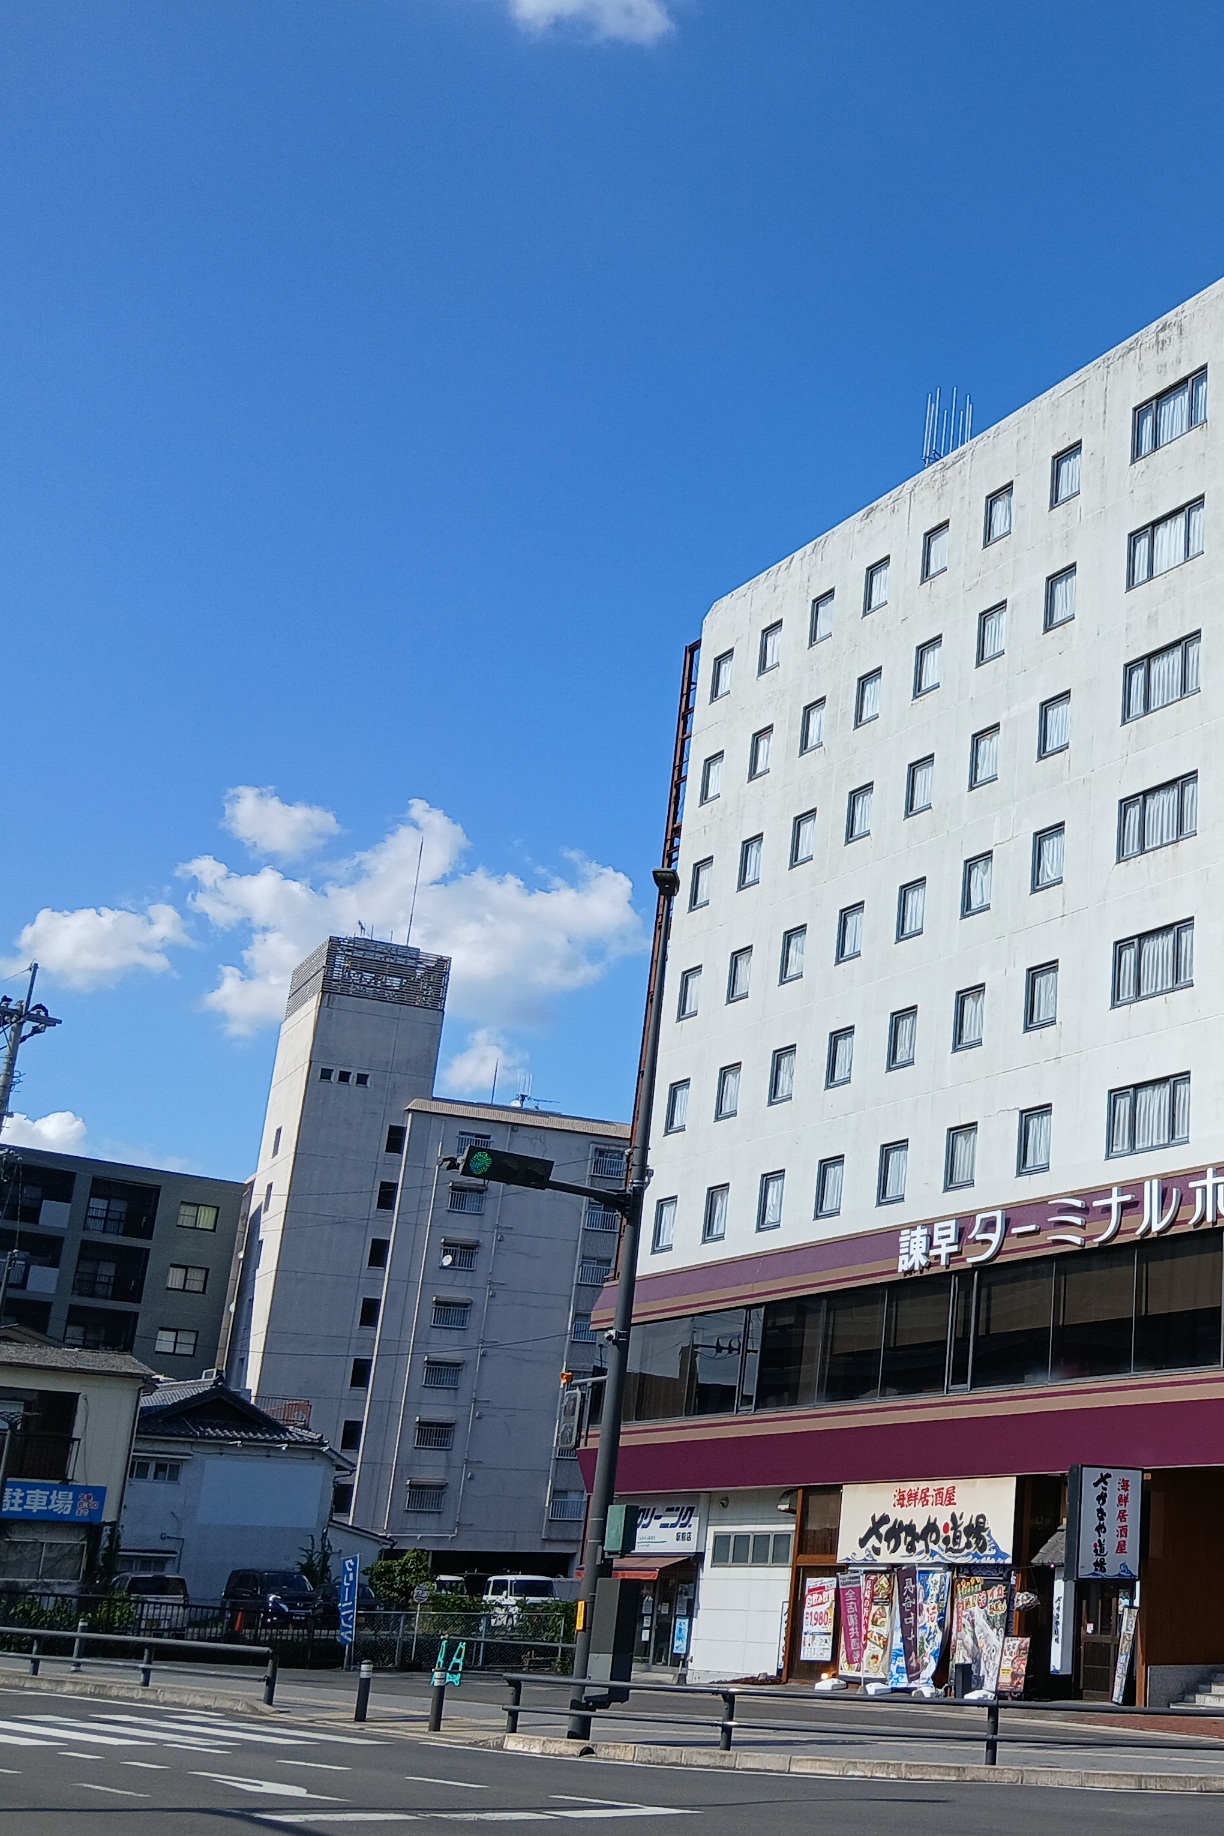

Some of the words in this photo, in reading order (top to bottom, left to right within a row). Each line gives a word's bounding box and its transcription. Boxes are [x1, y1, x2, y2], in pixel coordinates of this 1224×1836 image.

[2, 1488, 73, 1514] 駐車場
[893, 1486, 957, 1508] 海鮮居酒屋
[1115, 1478, 1130, 1555] 海鮮居酒屋
[859, 1511, 990, 1555] さかなや道場
[1093, 1473, 1112, 1573] さかなや道場
